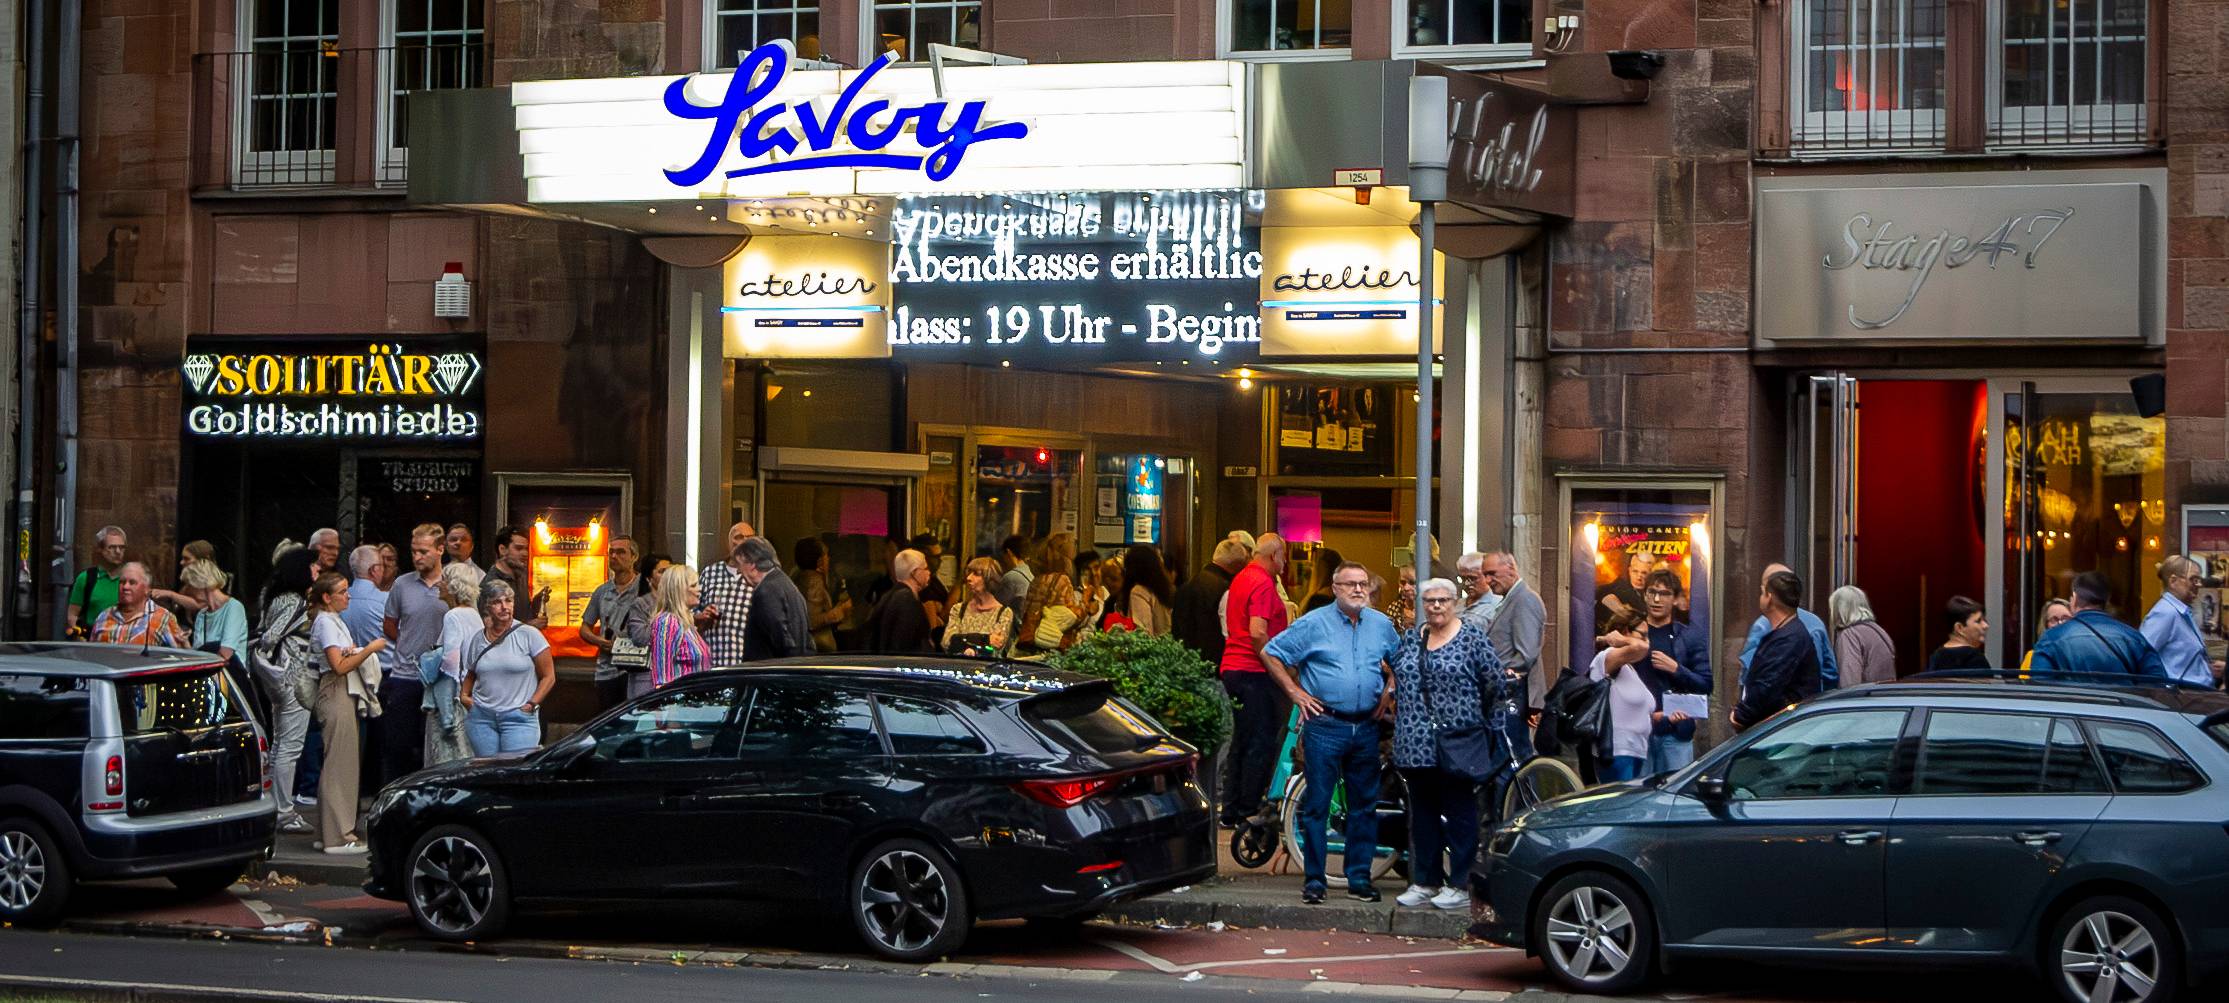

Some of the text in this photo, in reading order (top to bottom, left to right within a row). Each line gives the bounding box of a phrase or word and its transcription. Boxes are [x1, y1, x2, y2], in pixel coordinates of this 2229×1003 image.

[662, 42, 1028, 186] Savoy
[1349, 173, 1368, 183] 1254
[888, 236, 1099, 282] Abendkasse
[740, 272, 877, 297] atelier
[1273, 265, 1421, 291] atelier
[986, 305, 1031, 344] 19
[1039, 303, 1112, 344] Uhr
[1145, 301, 1262, 354] Begin
[217, 343, 435, 395] SOLITÄR
[189, 403, 470, 435] Goldschmiede
[1625, 541, 1689, 555] ZEITEN
